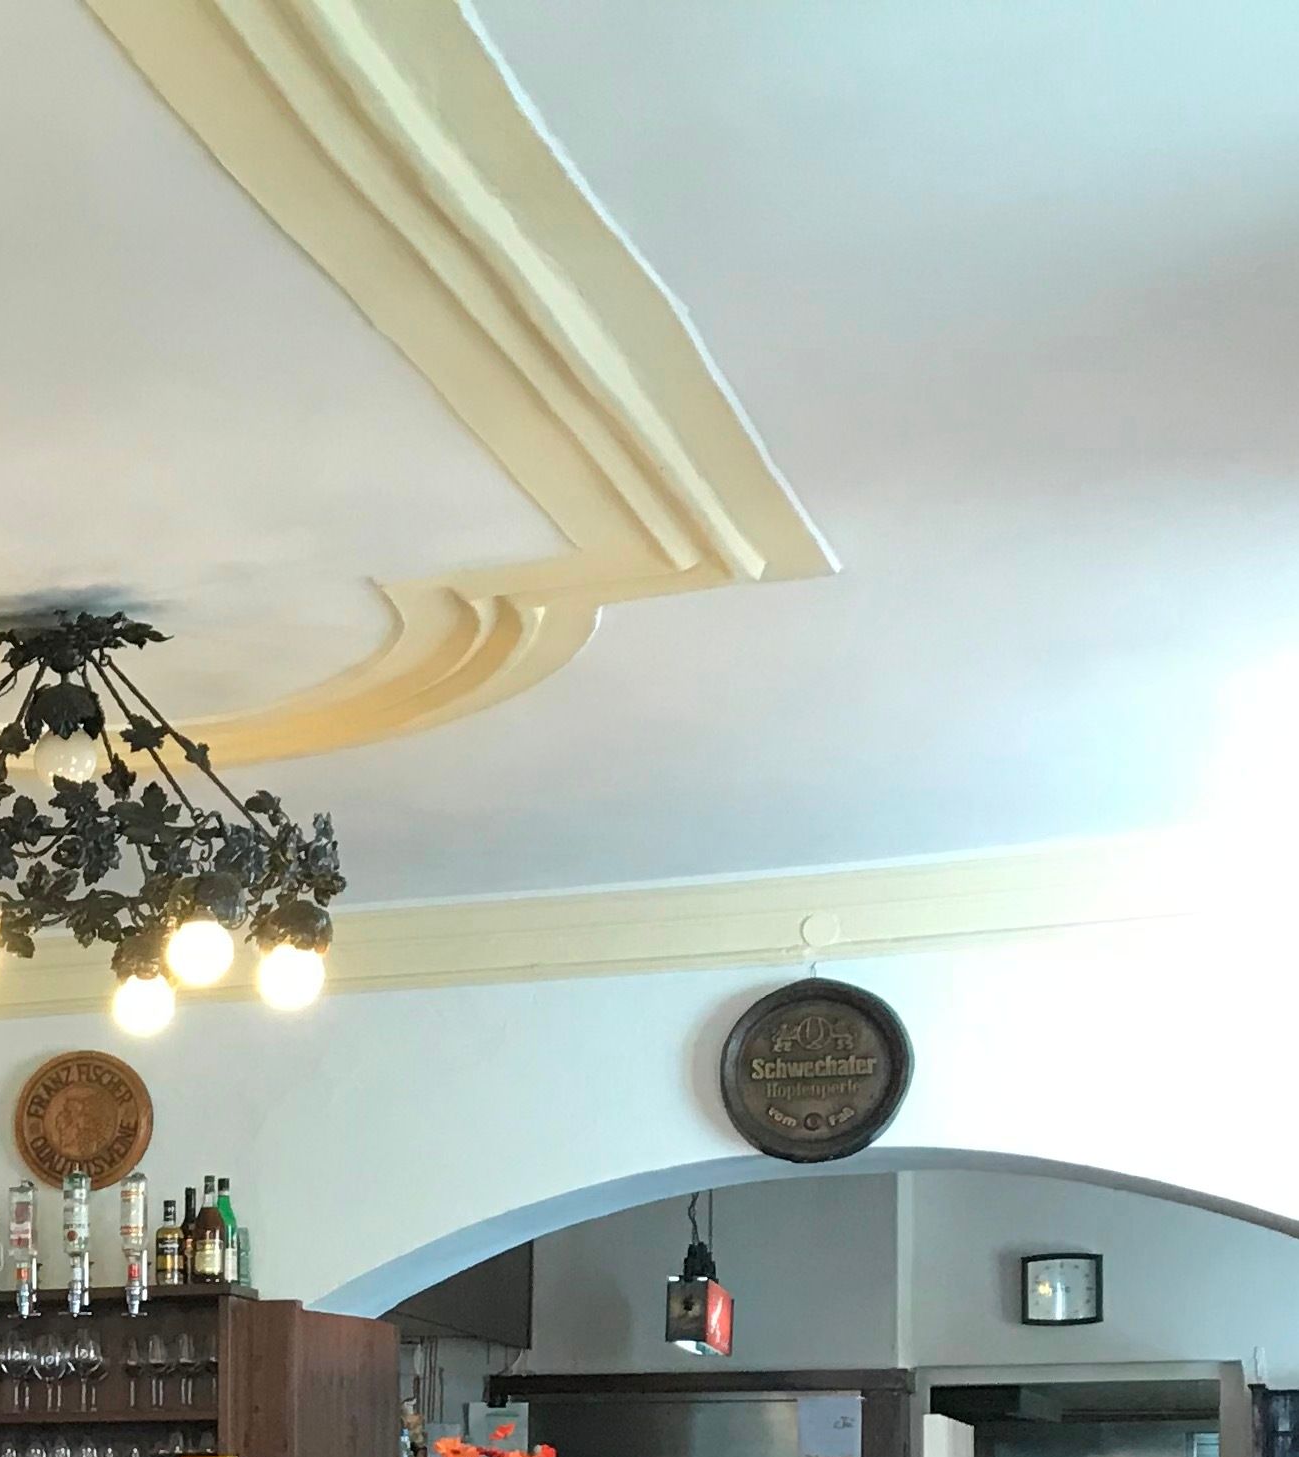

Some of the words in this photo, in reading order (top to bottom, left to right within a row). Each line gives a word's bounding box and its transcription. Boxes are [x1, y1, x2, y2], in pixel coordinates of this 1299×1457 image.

[750, 1054, 878, 1081] Schwechater
[25, 1065, 75, 1121] FRANZ
[76, 1062, 135, 1107] FISCHER
[767, 1105, 798, 1128] vom
